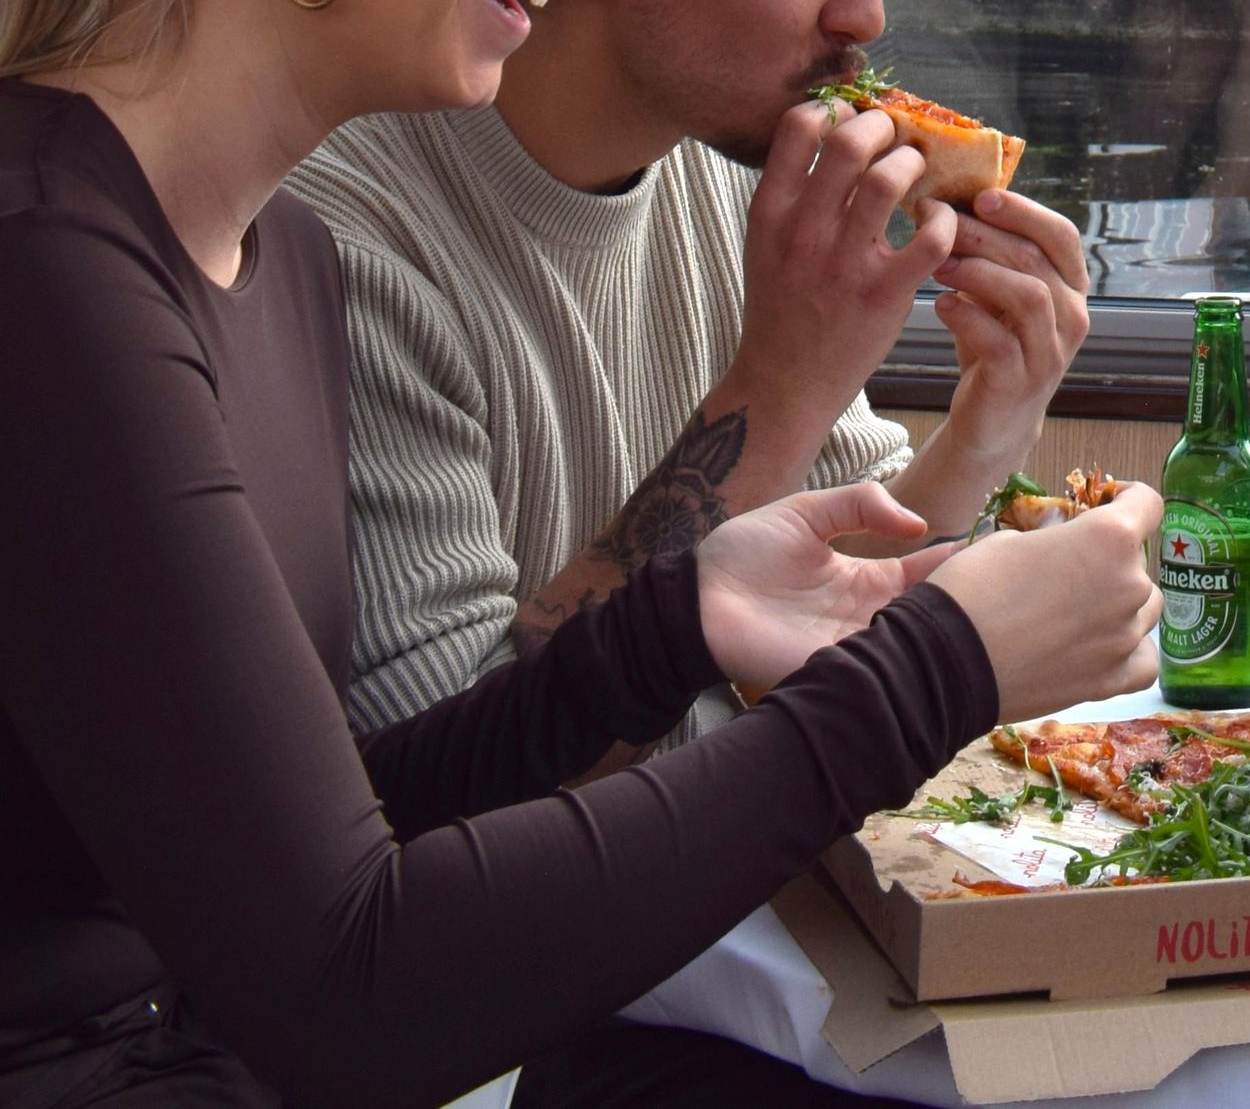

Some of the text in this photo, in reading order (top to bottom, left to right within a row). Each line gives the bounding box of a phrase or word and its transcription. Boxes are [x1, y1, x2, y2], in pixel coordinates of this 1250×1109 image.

[1193, 362, 1205, 424] Heineken
[1181, 514, 1219, 556] ORIGINAL
[1160, 564, 1229, 590] eineken
[1167, 631, 1188, 646] MALT
[1191, 615, 1218, 644] LAGER
